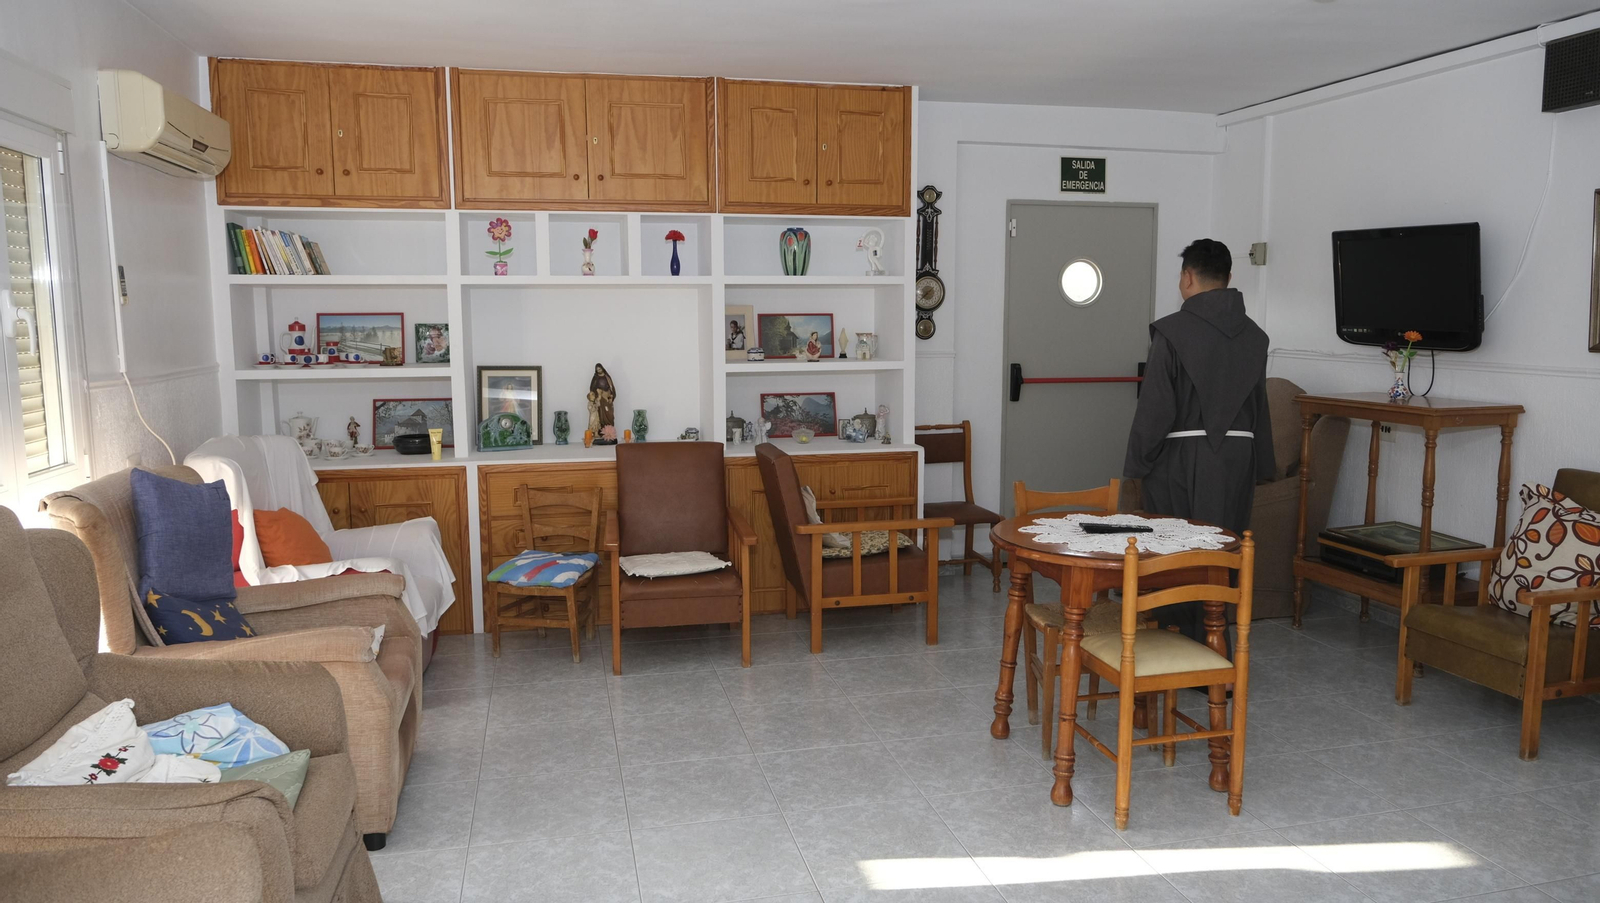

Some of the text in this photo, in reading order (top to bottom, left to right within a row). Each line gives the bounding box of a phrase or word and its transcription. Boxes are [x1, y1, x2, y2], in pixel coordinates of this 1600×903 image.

[1072, 160, 1096, 170] SALIDA
[1079, 170, 1088, 180] DE
[1062, 180, 1104, 190] EMERGENCIA
